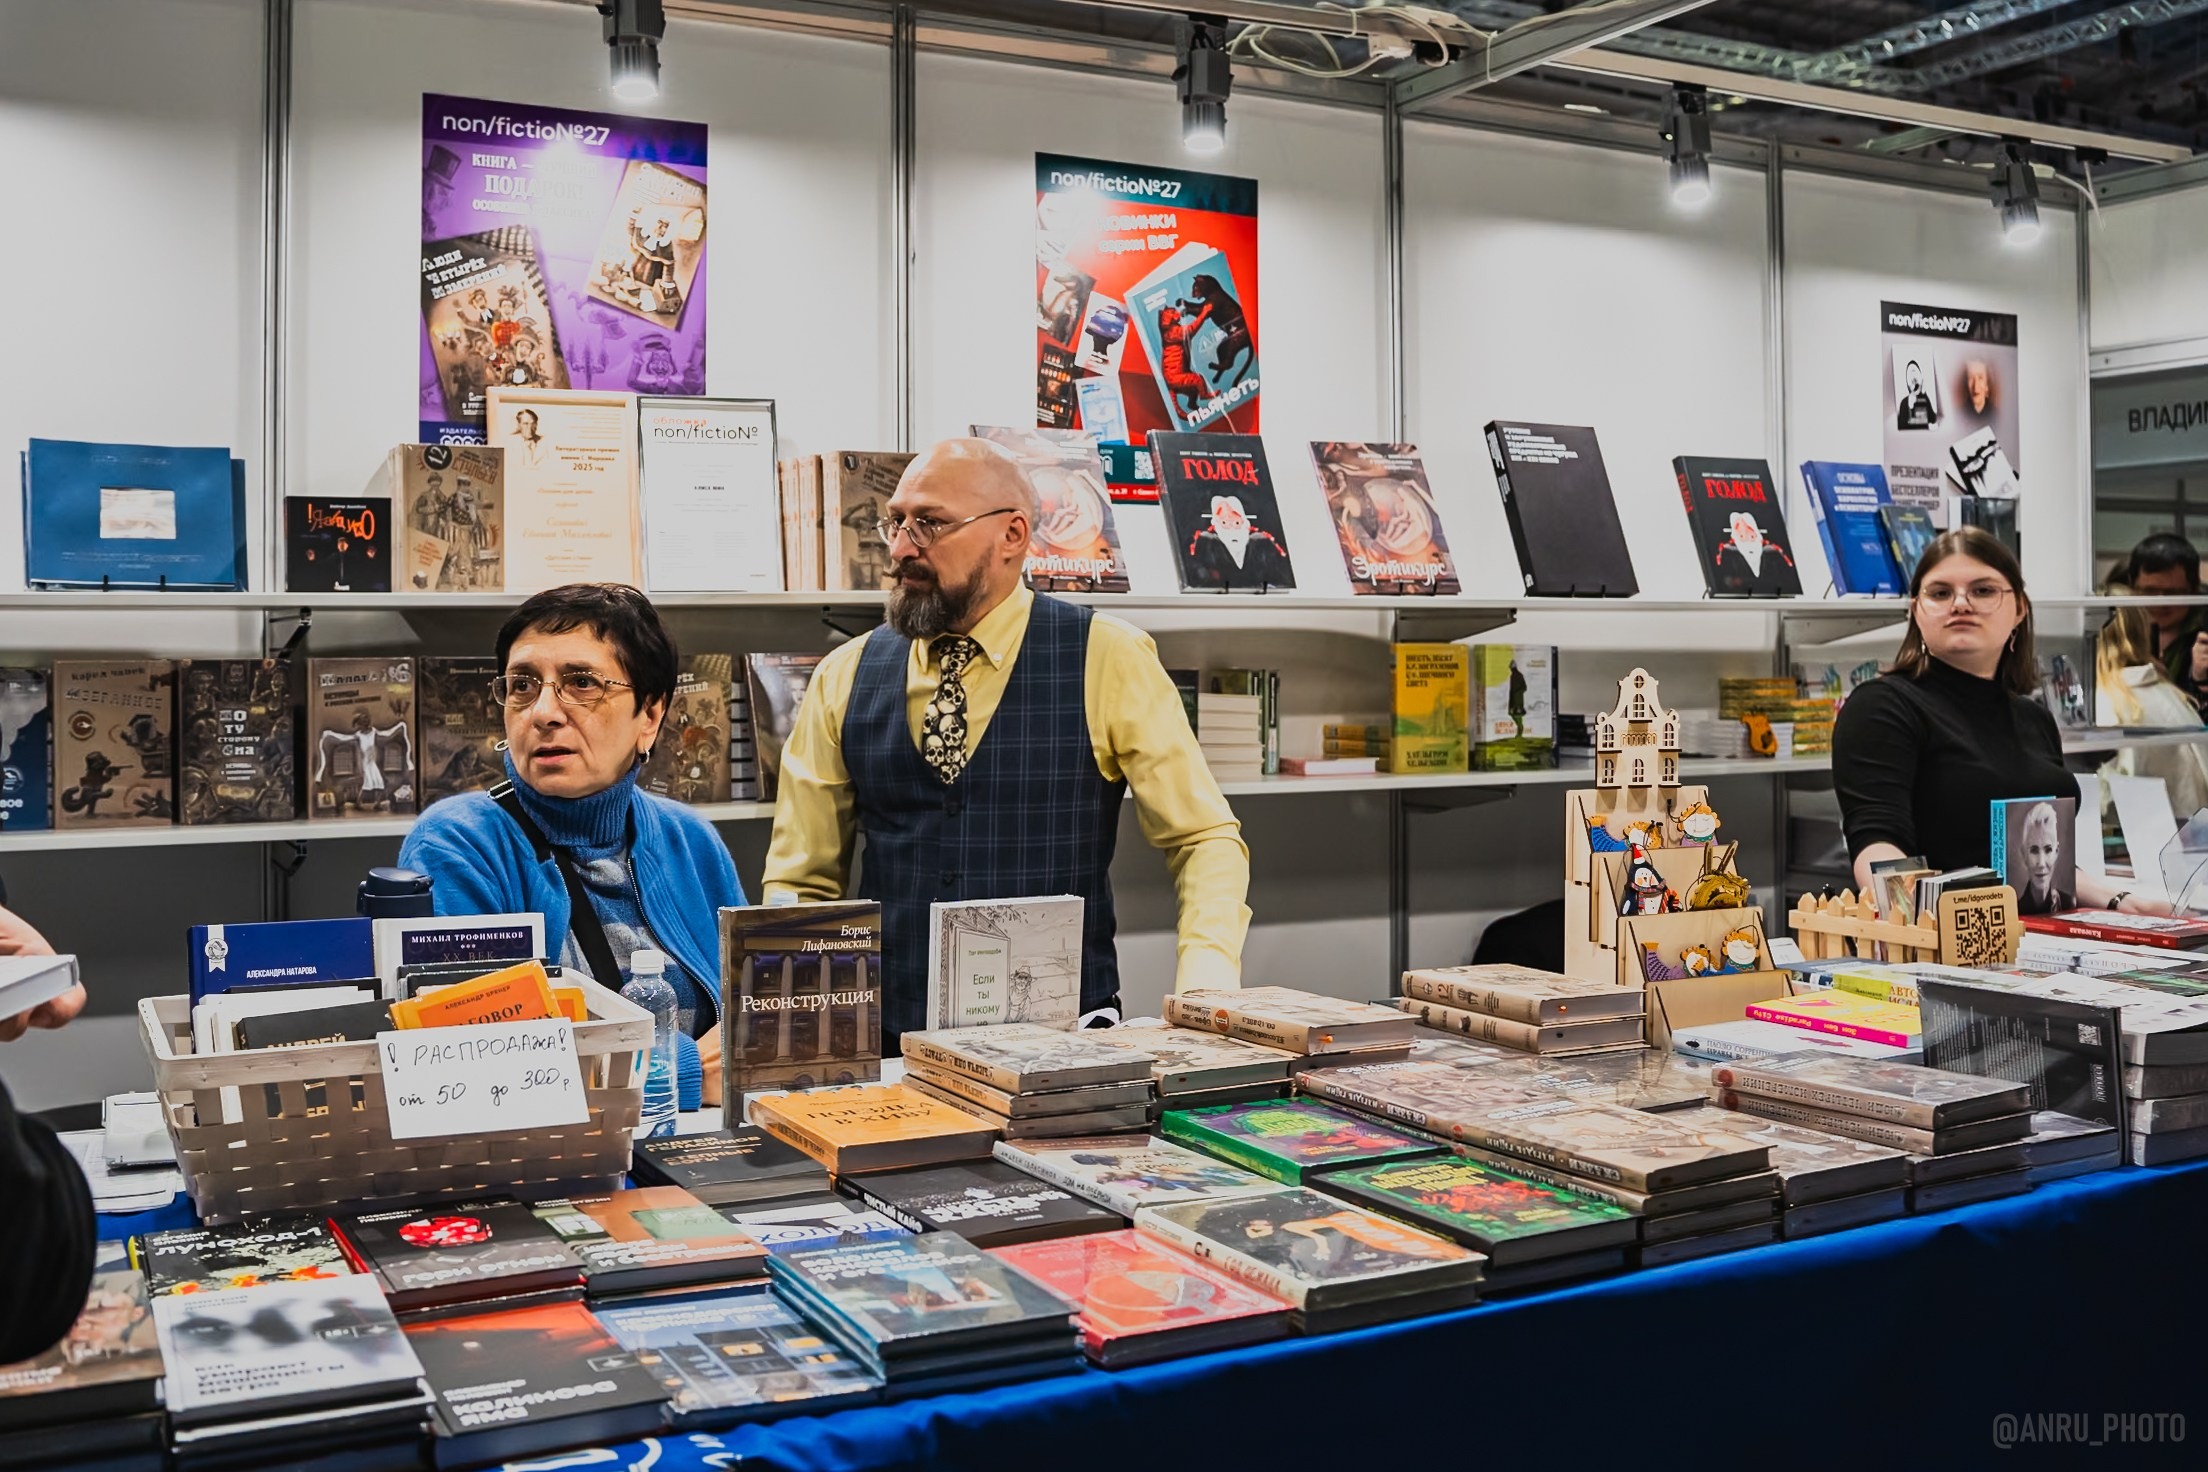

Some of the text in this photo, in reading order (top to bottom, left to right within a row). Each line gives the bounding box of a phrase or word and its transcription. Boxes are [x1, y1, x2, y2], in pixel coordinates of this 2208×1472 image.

[472, 153, 517, 170] КНИГА
[428, 446, 448, 465] 12
[572, 463, 593, 472] 2025
[1182, 458, 1260, 486] ГОЛОД
[1704, 478, 1767, 504] ГОЛОД
[1022, 555, 1117, 584] ротикурс
[1953, 892, 2004, 905] t.me/idgorodets
[411, 931, 525, 944] МИХАИЛ ТРОФИМЕНКОВ
[841, 924, 872, 939] Борис
[802, 936, 872, 953] Лифановский
[246, 966, 318, 979] АЛЕКСАНДРА НАТАРОВА
[973, 973, 996, 986] Если
[741, 990, 875, 1013] Реконструкция
[977, 991, 990, 1000] ты
[966, 1004, 1001, 1017] никому
[414, 1028, 567, 1066] РАСПРОДАЖА!
[399, 1093, 425, 1107] от
[437, 1082, 467, 1105] 50
[490, 1085, 509, 1107] до
[662, 1148, 755, 1163] СТЕПНЫЕ
[667, 1157, 720, 1166] БОГИ
[1569, 1158, 1621, 1182] СКАЗКИ
[864, 1192, 897, 1219] ЧИСТЫЙ
[154, 1226, 322, 1256] ЛУНОХОД-1
